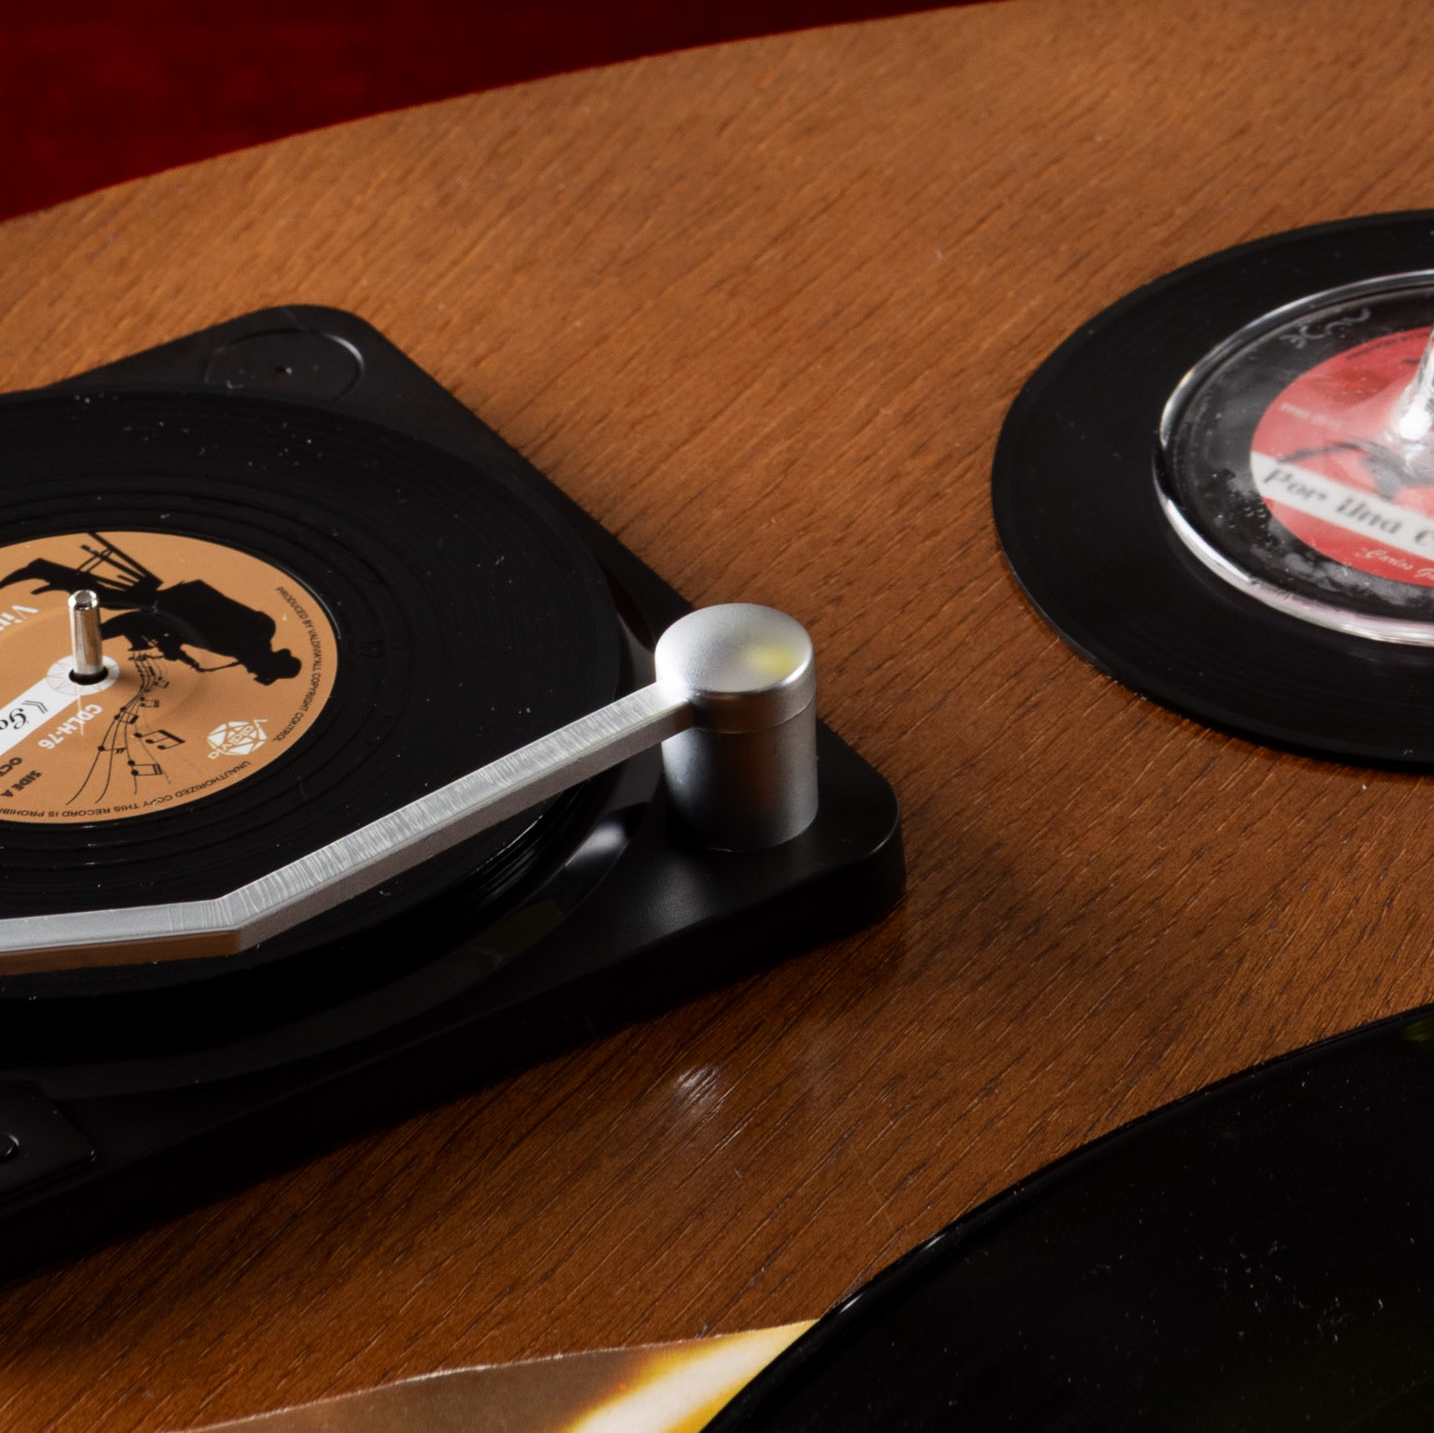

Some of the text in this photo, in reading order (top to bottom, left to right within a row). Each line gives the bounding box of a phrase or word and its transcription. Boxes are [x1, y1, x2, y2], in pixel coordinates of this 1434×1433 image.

[276, 587, 308, 620] PRODUCED
[303, 619, 312, 628] BY
[303, 673, 321, 712] COPYRIGHT
[38, 704, 103, 750] CDLH-76
[272, 711, 304, 742] CONTROL
[1, 770, 41, 798] SIDE A
[175, 761, 251, 797] UNAUTHORIZED
[62, 807, 110, 817] RECORD
[114, 802, 138, 812] THIS
[143, 794, 172, 807] COPY
